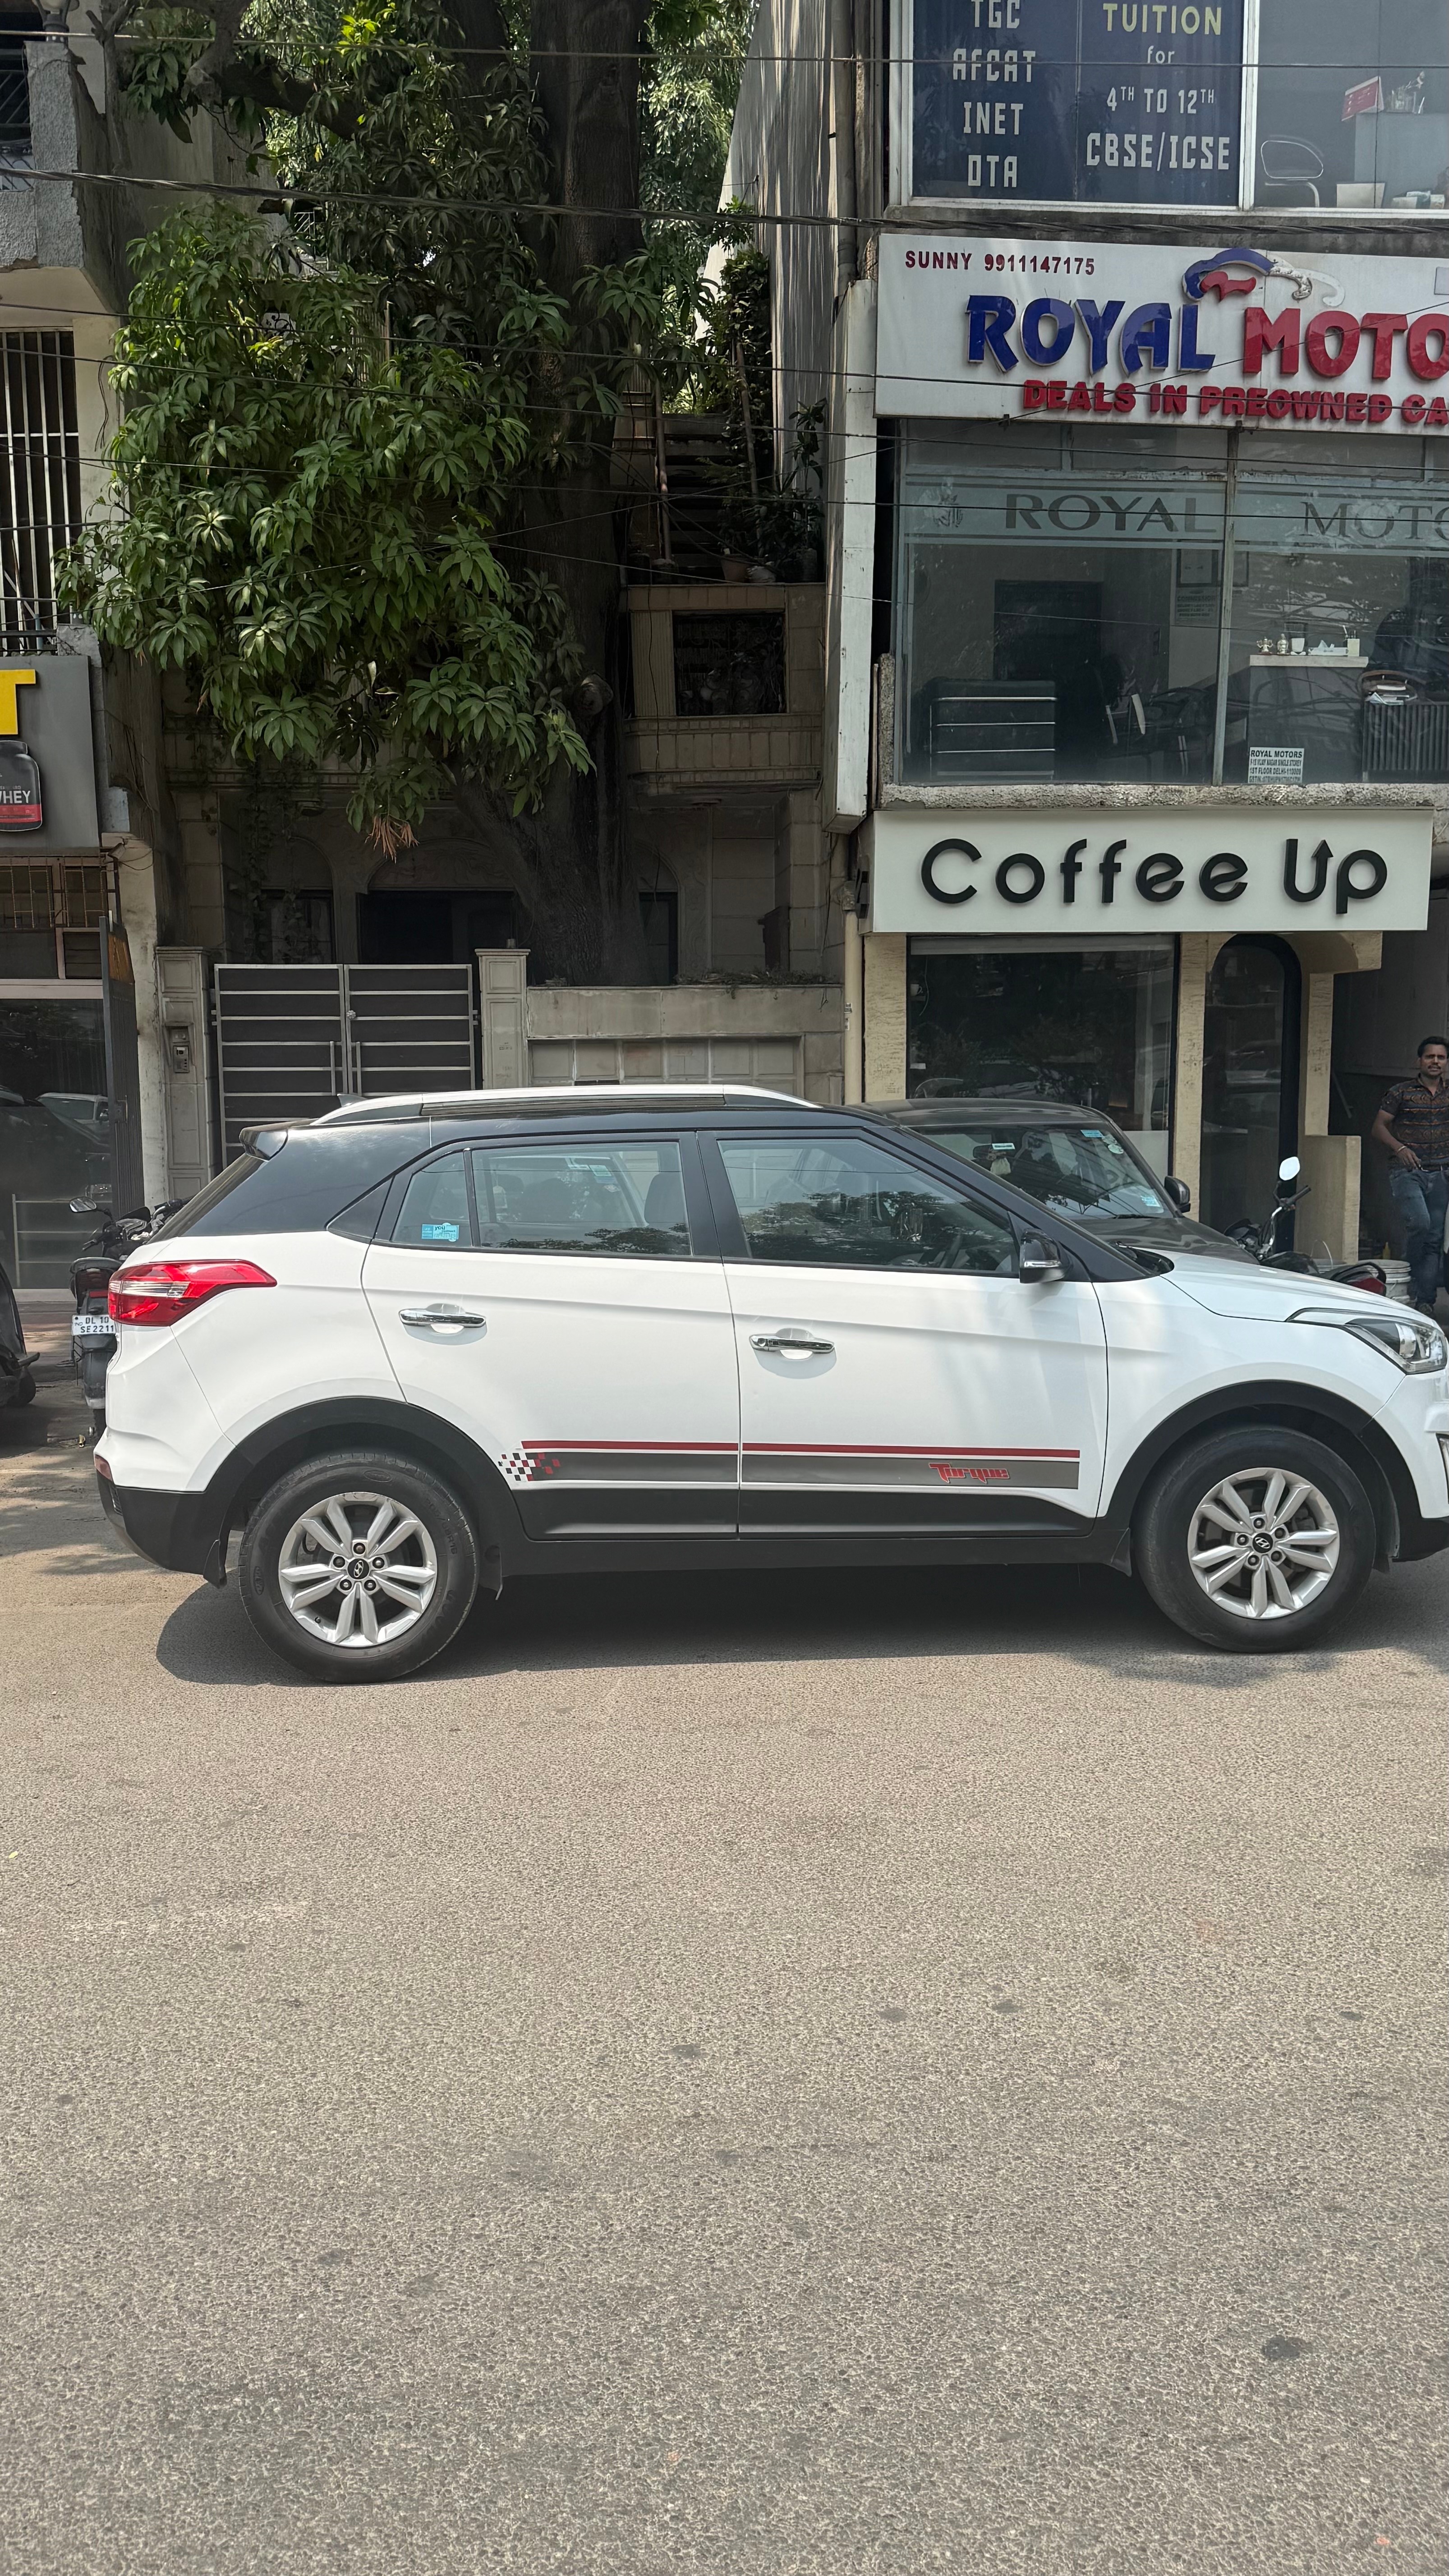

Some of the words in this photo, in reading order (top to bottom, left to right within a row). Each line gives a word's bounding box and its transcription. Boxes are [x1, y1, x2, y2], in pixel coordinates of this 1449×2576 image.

[973, 0, 1020, 28] TGC
[1103, 3, 1222, 35] TUITION
[952, 48, 1036, 83] AFCAT
[1147, 45, 1175, 64] for
[1144, 88, 1167, 113] TO
[963, 102, 1023, 135] INET
[1086, 132, 1230, 171] CBSE/ICSE
[968, 155, 1017, 187] OTA
[905, 250, 972, 270] SUNNY
[984, 253, 1095, 275] 9911147175
[965, 294, 1216, 376] ROYAL
[1242, 307, 1449, 381] MOTO
[1023, 380, 1136, 413] DEALS
[1150, 383, 1187, 414] IN
[1200, 385, 1393, 423] PREOWNED
[1401, 394, 1449, 426] CA
[1005, 493, 1217, 533] ROYAL
[0, 790, 31, 804] HEY
[921, 838, 1248, 904] Coffee
[1283, 838, 1388, 915] Up
[928, 1463, 1010, 1484] Torque
